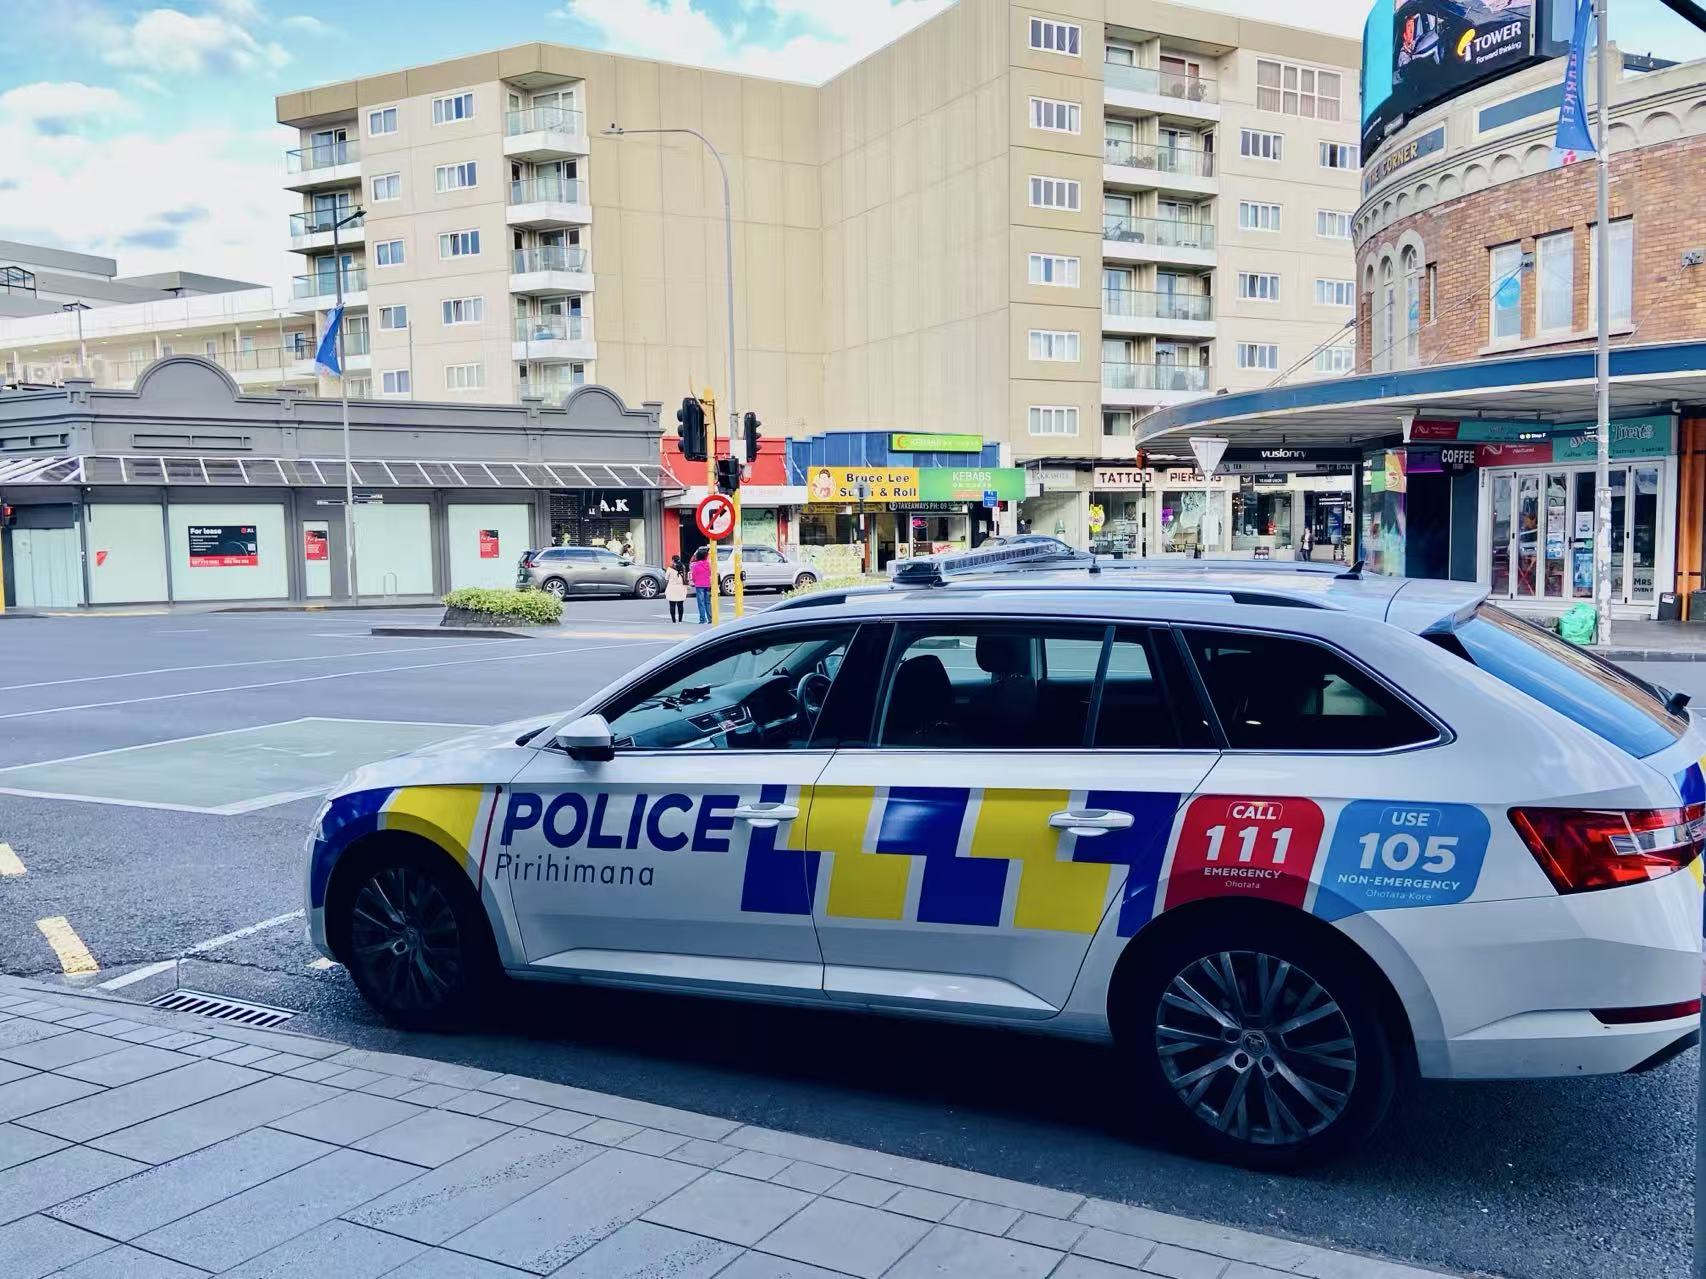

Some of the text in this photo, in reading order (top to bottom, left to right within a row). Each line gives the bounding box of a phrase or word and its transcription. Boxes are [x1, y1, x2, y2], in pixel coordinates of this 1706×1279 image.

[1474, 22, 1521, 52] TOWER
[1476, 41, 1522, 64] Forward thinking
[1383, 141, 1418, 176] CORNER
[1441, 449, 1475, 463] COFFEE
[847, 474, 910, 482] Bruce Lee
[952, 472, 992, 481] KEBABS
[840, 488, 916, 496] Sui & Roll
[1633, 578, 1652, 586] MRS
[1232, 805, 1277, 820] CALL
[1391, 811, 1430, 826] USE
[501, 792, 740, 852] POLICE
[1206, 825, 1293, 864] 111
[1359, 832, 1459, 874] 105
[495, 853, 654, 886] Pirihimana
[1204, 867, 1282, 878] EMERGENCY
[1224, 880, 1260, 889] Ohotata
[1337, 874, 1461, 890] NON-EMERGENCY
[1365, 889, 1432, 901] Ohotata Kore
